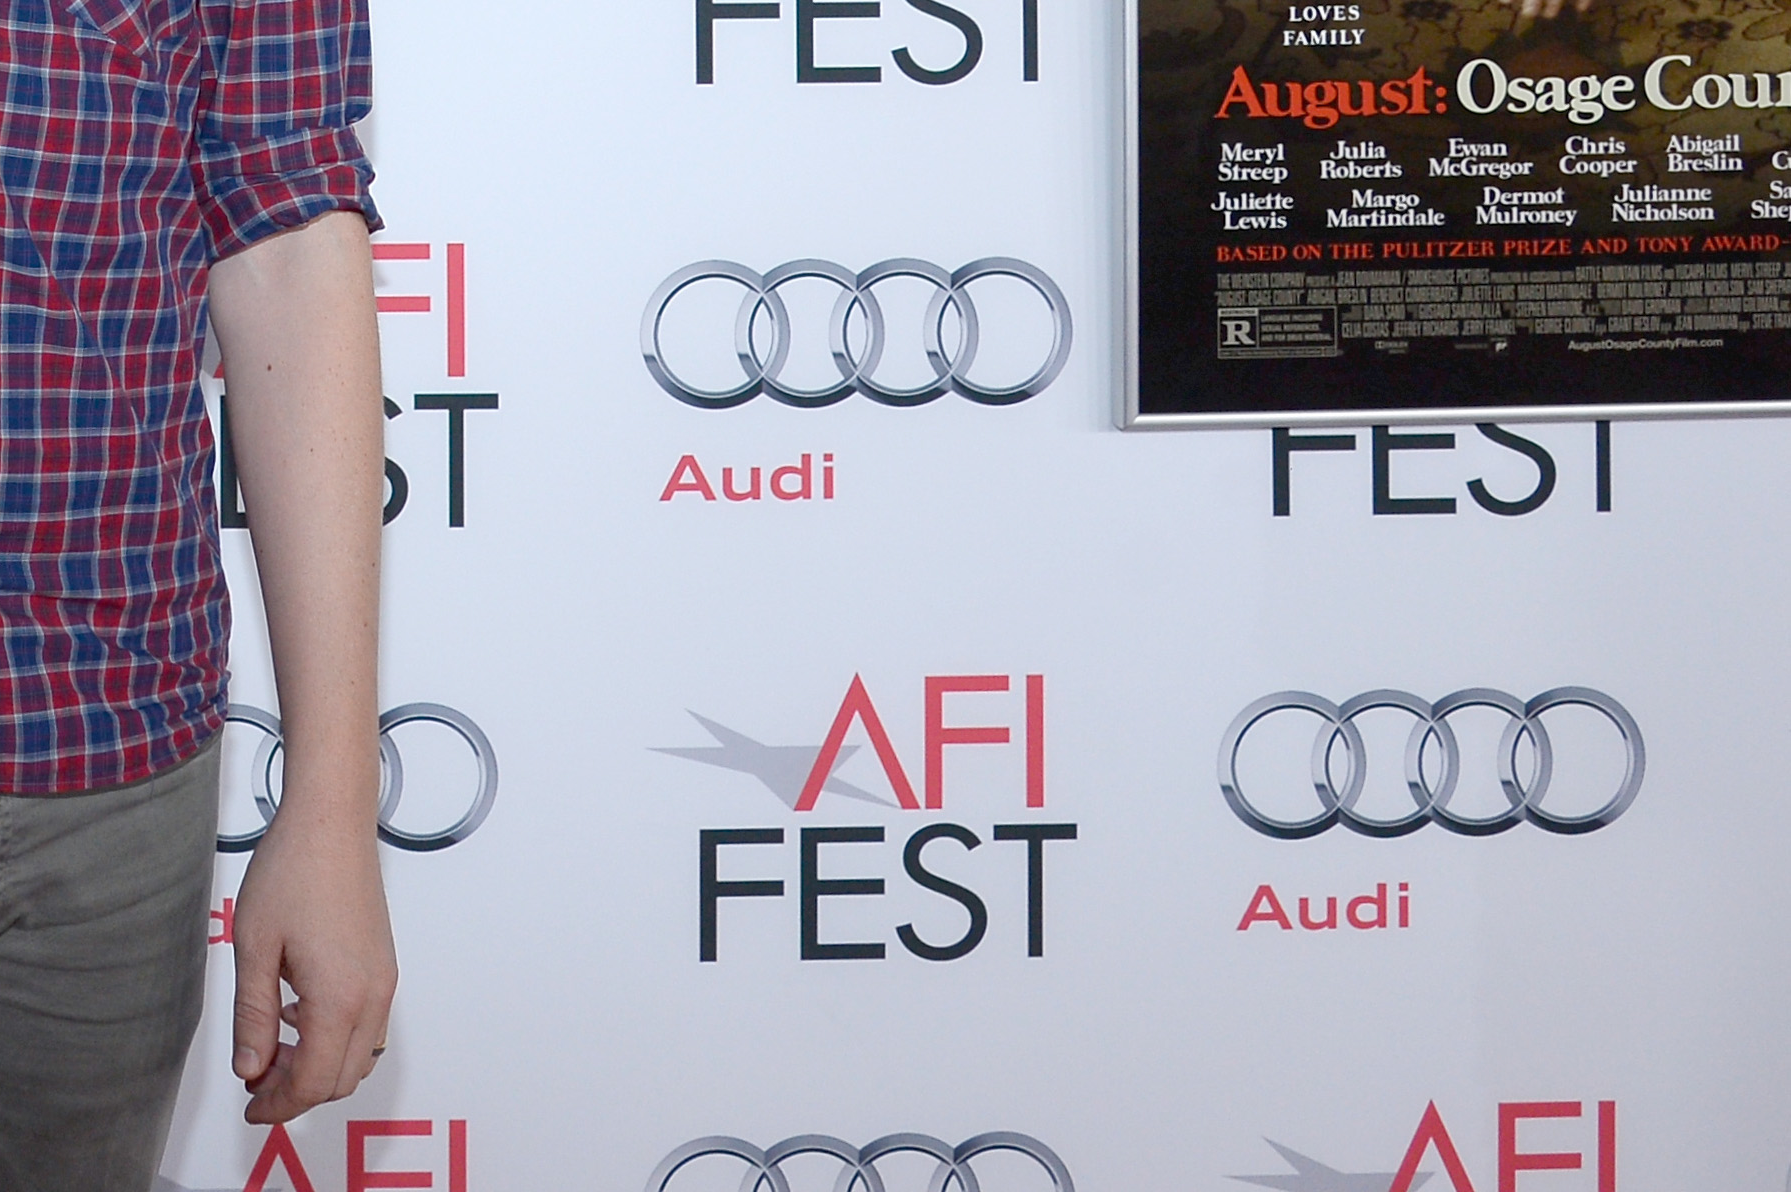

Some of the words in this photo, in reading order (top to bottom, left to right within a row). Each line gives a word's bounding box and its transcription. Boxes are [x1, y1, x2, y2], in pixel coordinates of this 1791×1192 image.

[1288, 4, 1360, 23] LOVES
[1282, 28, 1367, 48] FAMILY
[1214, 64, 1448, 129] August:
[1455, 58, 1635, 124] Osage
[1221, 142, 1285, 165] Meryl
[1329, 140, 1387, 160] Julia
[1448, 138, 1508, 158] Ewan
[1565, 135, 1627, 156] Chris
[1666, 134, 1741, 156] Abigail
[1218, 162, 1289, 184] Streep
[1320, 160, 1403, 180] Roberts
[1428, 157, 1534, 180] McGregor
[1559, 155, 1638, 178] Cooper
[1667, 153, 1744, 173] Breslin
[1211, 192, 1294, 212] Juliette
[1352, 189, 1421, 211] Margo
[1483, 186, 1565, 206] Dermot
[1614, 184, 1713, 204] Julianne
[1223, 211, 1288, 230] Lewis
[1326, 209, 1446, 229] Martindale
[1476, 207, 1578, 227] Mulroney
[1612, 203, 1715, 223] Nicholson
[1751, 199, 1791, 222] She
[1217, 245, 1286, 263] BASED
[1292, 243, 1322, 260] ON
[1328, 242, 1374, 260] THE
[1383, 240, 1495, 259] PULITZER
[1502, 238, 1572, 256] PRIZE
[1581, 238, 1629, 254] AND
[1636, 236, 1693, 254] TONY
[1221, 320, 1255, 346] R
[1568, 337, 1724, 352] AugustOsageCountyFilm.com
[662, 454, 834, 501] Audi
[796, 675, 1044, 811] AFI
[700, 824, 1077, 961] FEST
[1239, 883, 1409, 930] Audi
[245, 1120, 467, 1192] AFI
[1390, 1101, 1616, 1192] AFI
